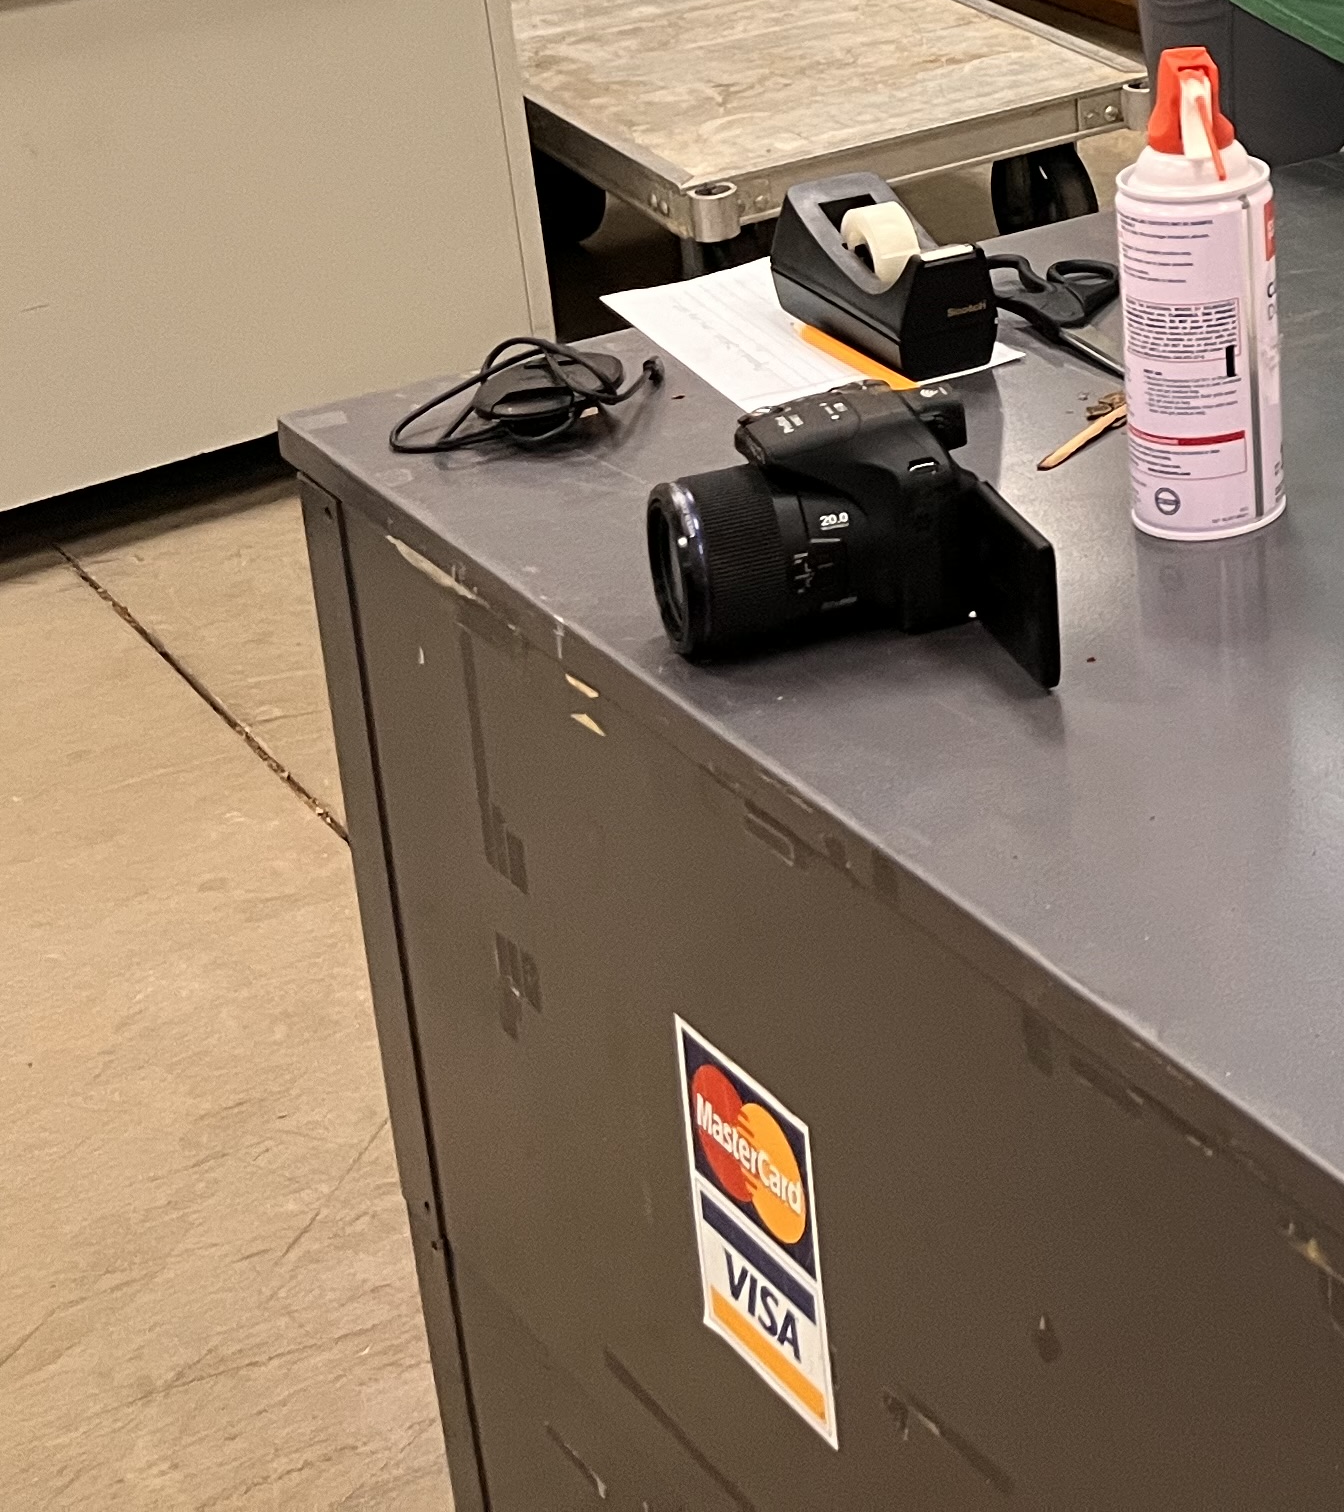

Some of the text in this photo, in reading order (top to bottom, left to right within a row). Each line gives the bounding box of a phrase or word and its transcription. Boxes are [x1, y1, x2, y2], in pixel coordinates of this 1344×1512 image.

[946, 299, 987, 318] Scotch
[819, 511, 850, 527] 20.0
[696, 1092, 804, 1215] MasterCard
[723, 1246, 803, 1365] VISA
